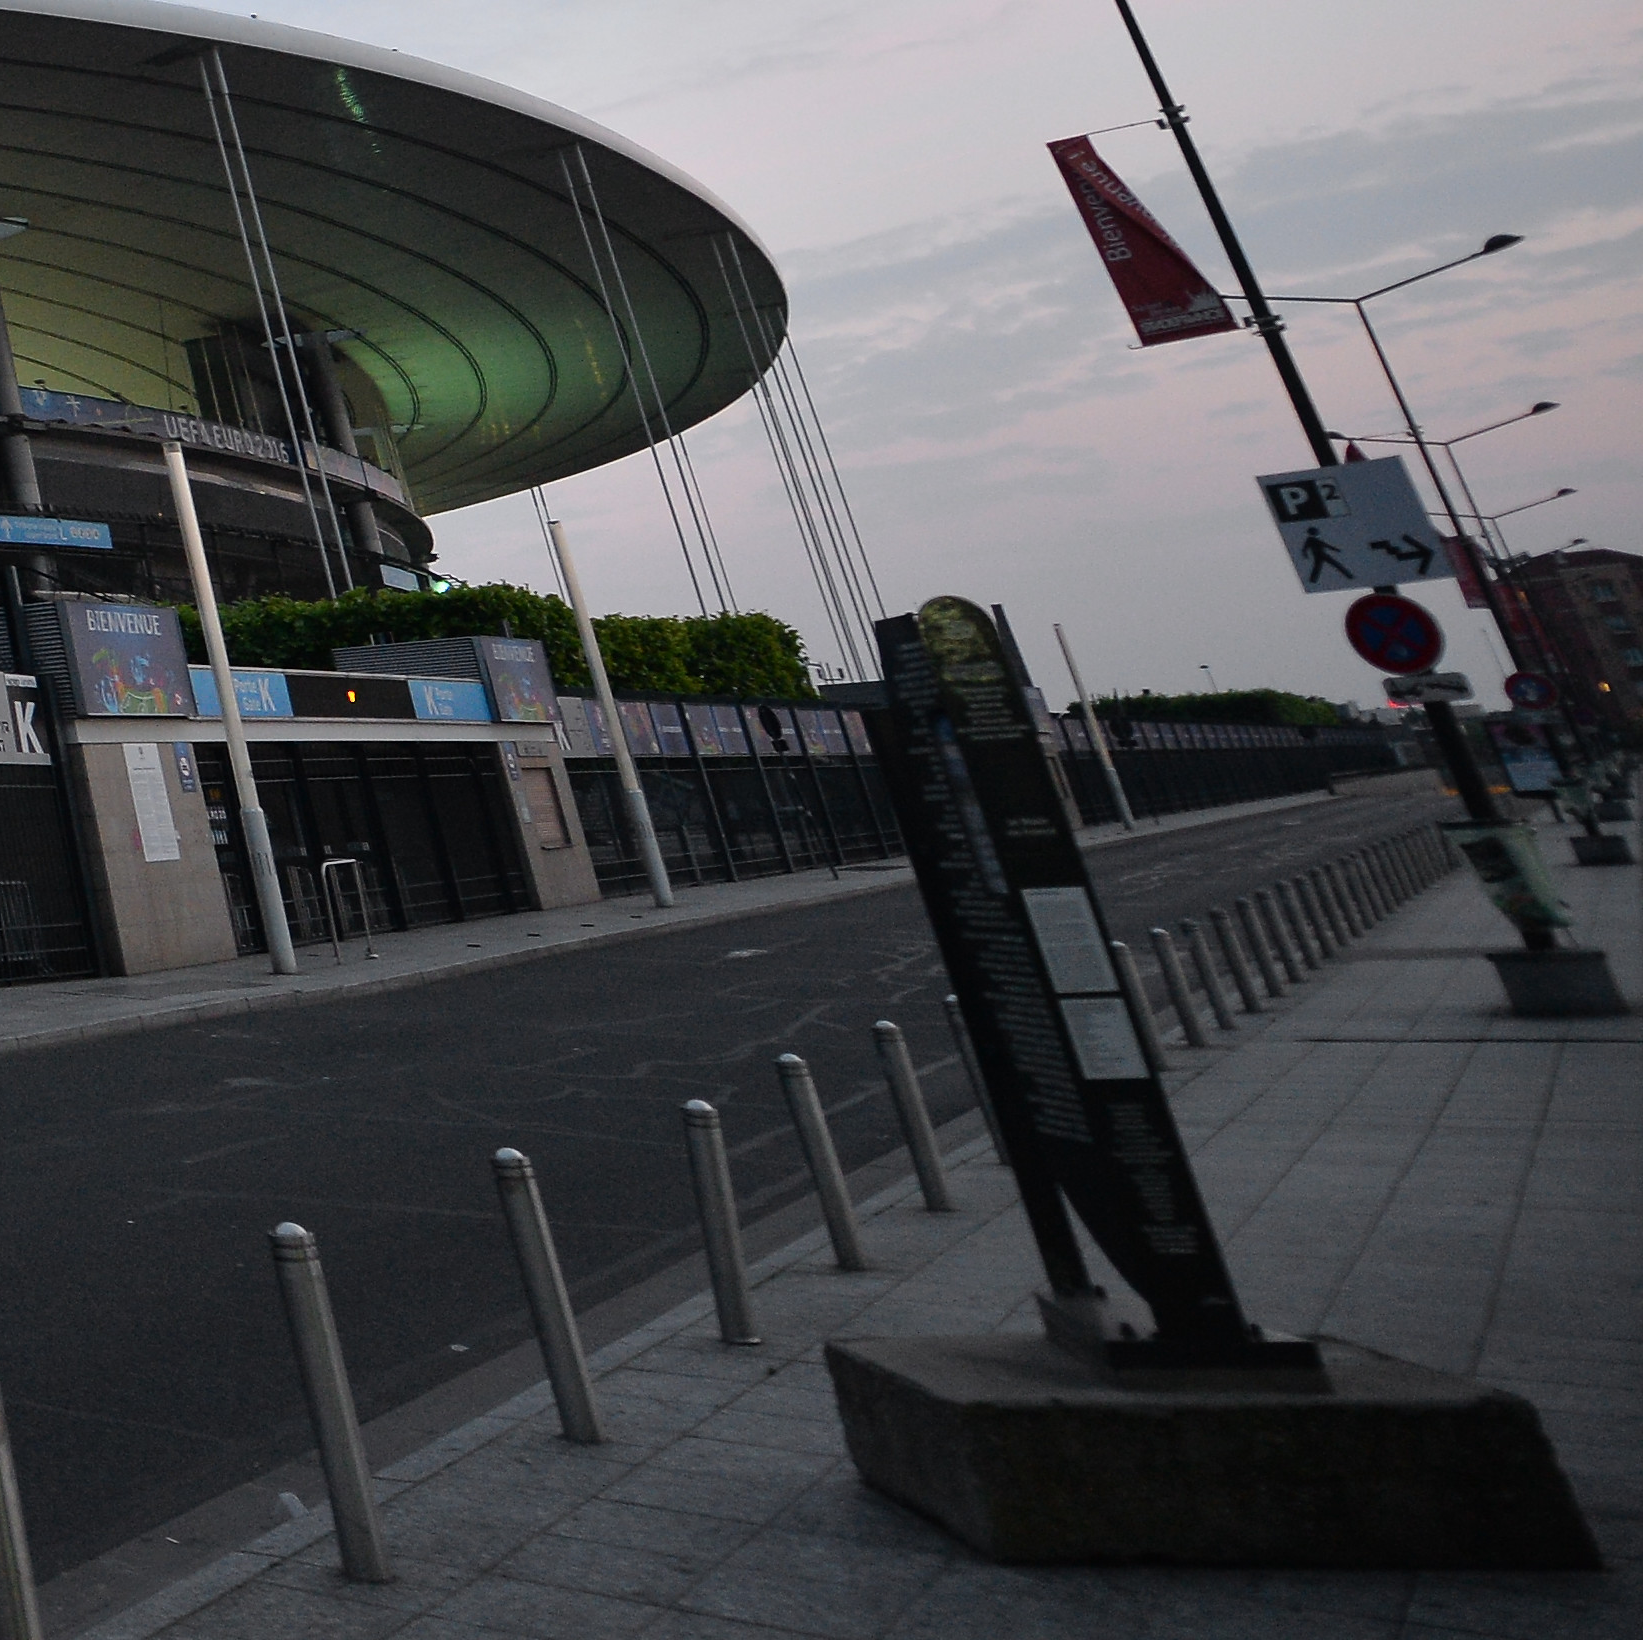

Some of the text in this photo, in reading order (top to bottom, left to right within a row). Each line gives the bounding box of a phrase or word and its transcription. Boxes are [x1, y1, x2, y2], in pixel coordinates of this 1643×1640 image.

[163, 414, 212, 446] UEFA
[213, 425, 256, 456] EURO
[1279, 486, 1310, 515] P
[85, 609, 162, 636] BIENVENUE
[258, 678, 276, 711] K
[14, 700, 44, 754] K
